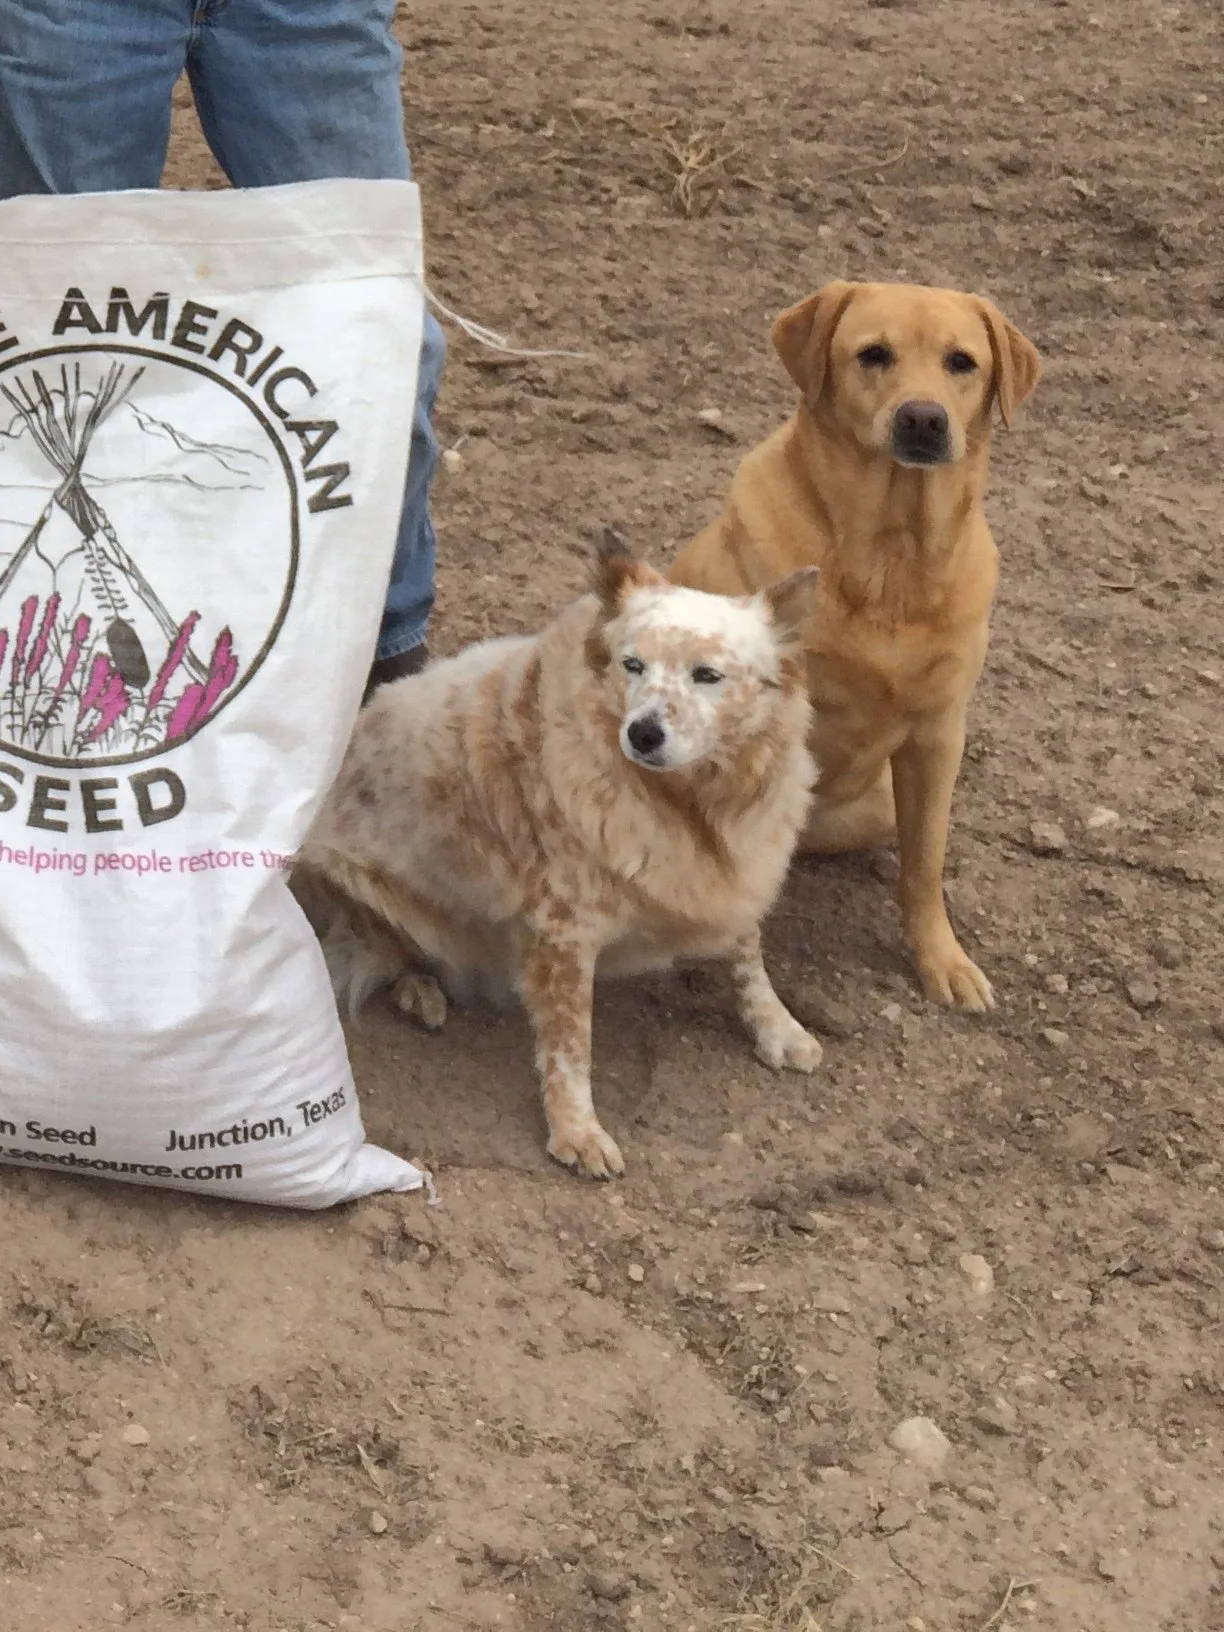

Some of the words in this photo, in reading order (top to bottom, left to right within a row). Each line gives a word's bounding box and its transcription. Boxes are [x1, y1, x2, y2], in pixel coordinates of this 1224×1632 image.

[52, 286, 352, 516] AMERICAN
[94, 848, 172, 876] people
[179, 848, 254, 874] restore
[26, 1120, 97, 1147] Seed
[165, 1117, 292, 1151] Junction,
[296, 1086, 346, 1127] Texas
